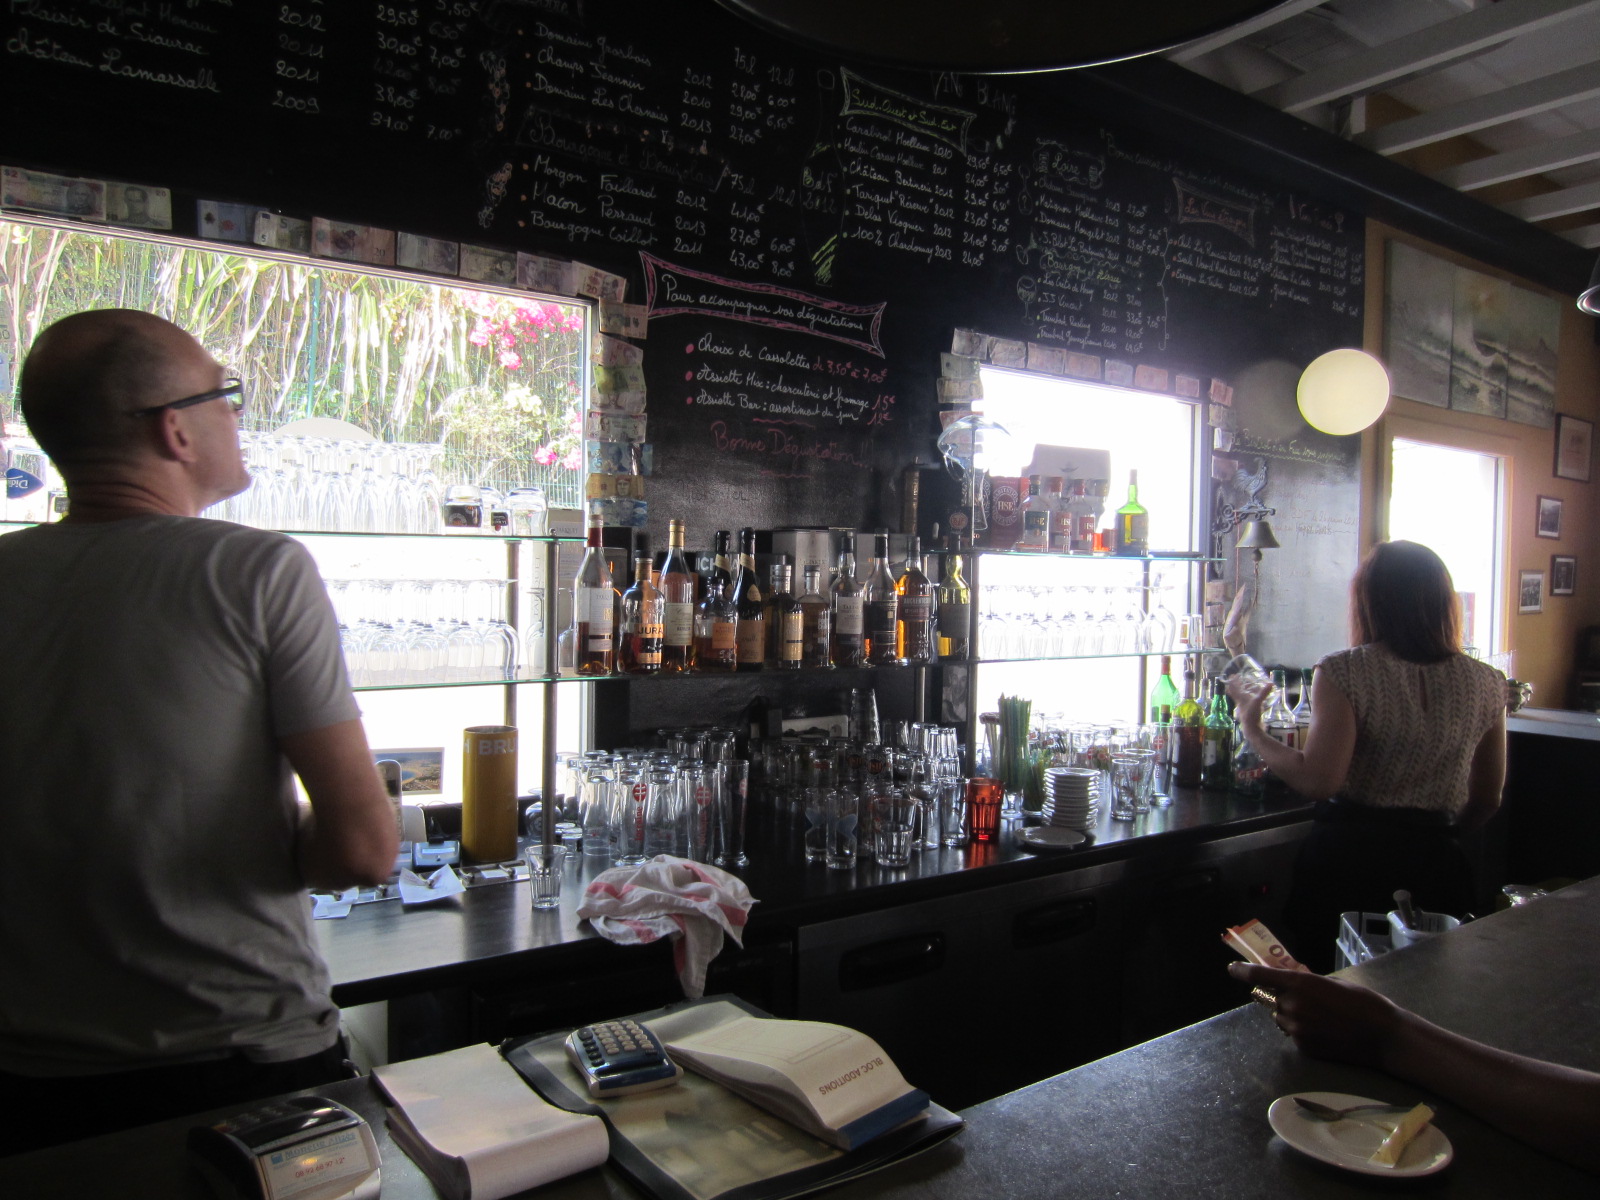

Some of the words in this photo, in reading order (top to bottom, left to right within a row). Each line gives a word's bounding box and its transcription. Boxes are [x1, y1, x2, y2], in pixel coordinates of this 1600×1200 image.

[279, 6, 326, 32] 2012
[97, 16, 120, 36] de
[275, 60, 319, 83] 2011
[683, 67, 713, 89] 2012
[272, 90, 320, 114] 2009
[682, 91, 712, 110] 2010
[680, 113, 712, 134] 2013
[933, 143, 953, 160] 2010
[676, 190, 708, 212] 2012
[934, 184, 954, 198] 2012
[934, 203, 956, 219] 2012
[675, 216, 706, 237] 2013
[851, 226, 883, 246] 100%
[933, 223, 953, 238] 2012
[673, 236, 703, 255] 2011
[662, 274, 695, 303] Pour
[699, 292, 771, 316] accompagner
[775, 304, 795, 318] vos
[739, 343, 752, 358] de
[709, 420, 766, 453] Bonne
[638, 626, 664, 635] JURA
[861, 1057, 884, 1073] BLOC
[818, 1068, 861, 1095] ADDITIONS
